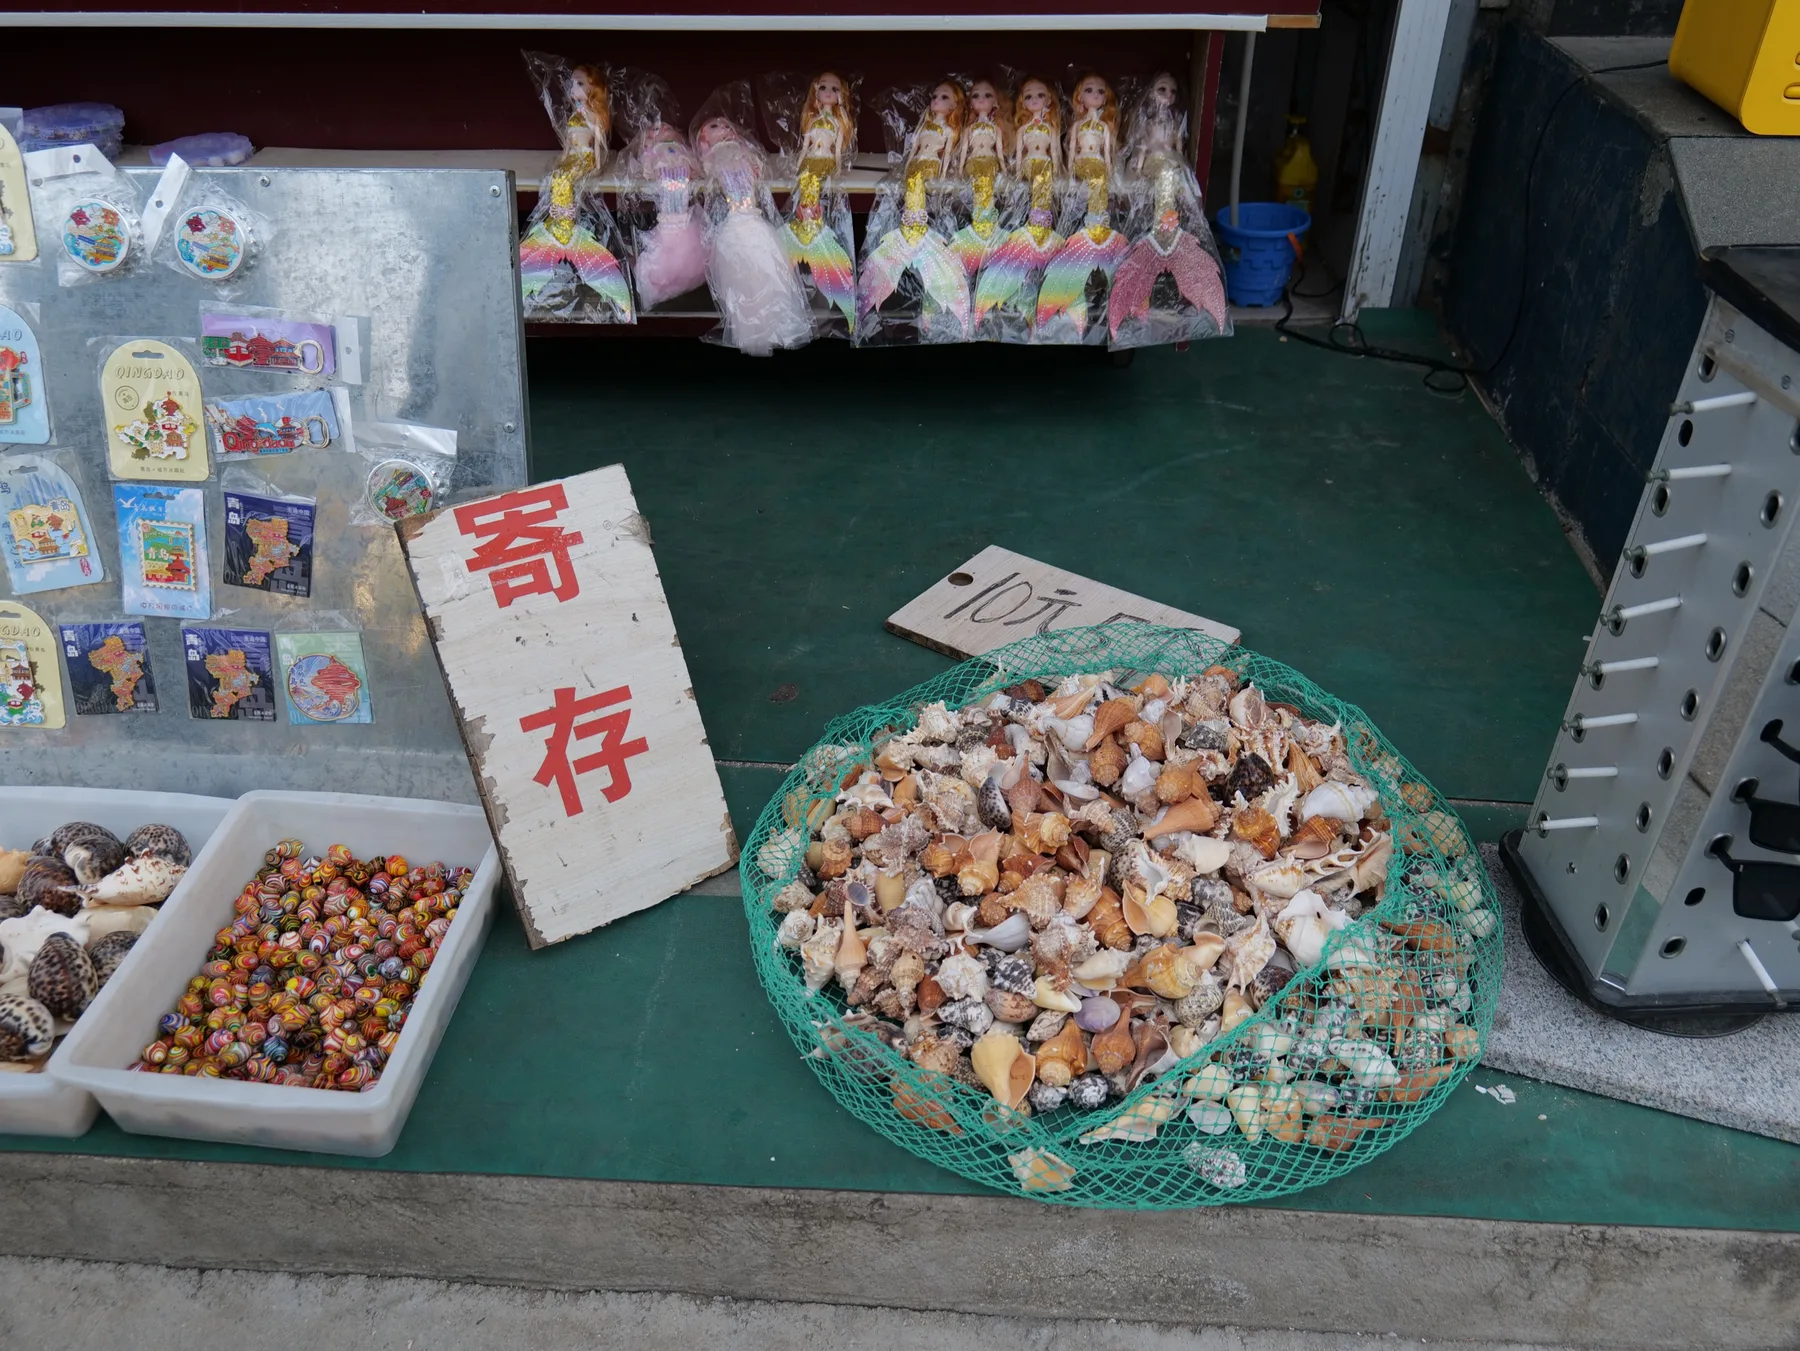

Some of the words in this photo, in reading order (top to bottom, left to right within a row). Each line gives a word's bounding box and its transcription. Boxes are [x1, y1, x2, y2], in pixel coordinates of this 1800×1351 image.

[115, 366, 185, 380] QINGDAO
[0, 624, 41, 637] GDAO
[453, 483, 650, 818] 寄存
